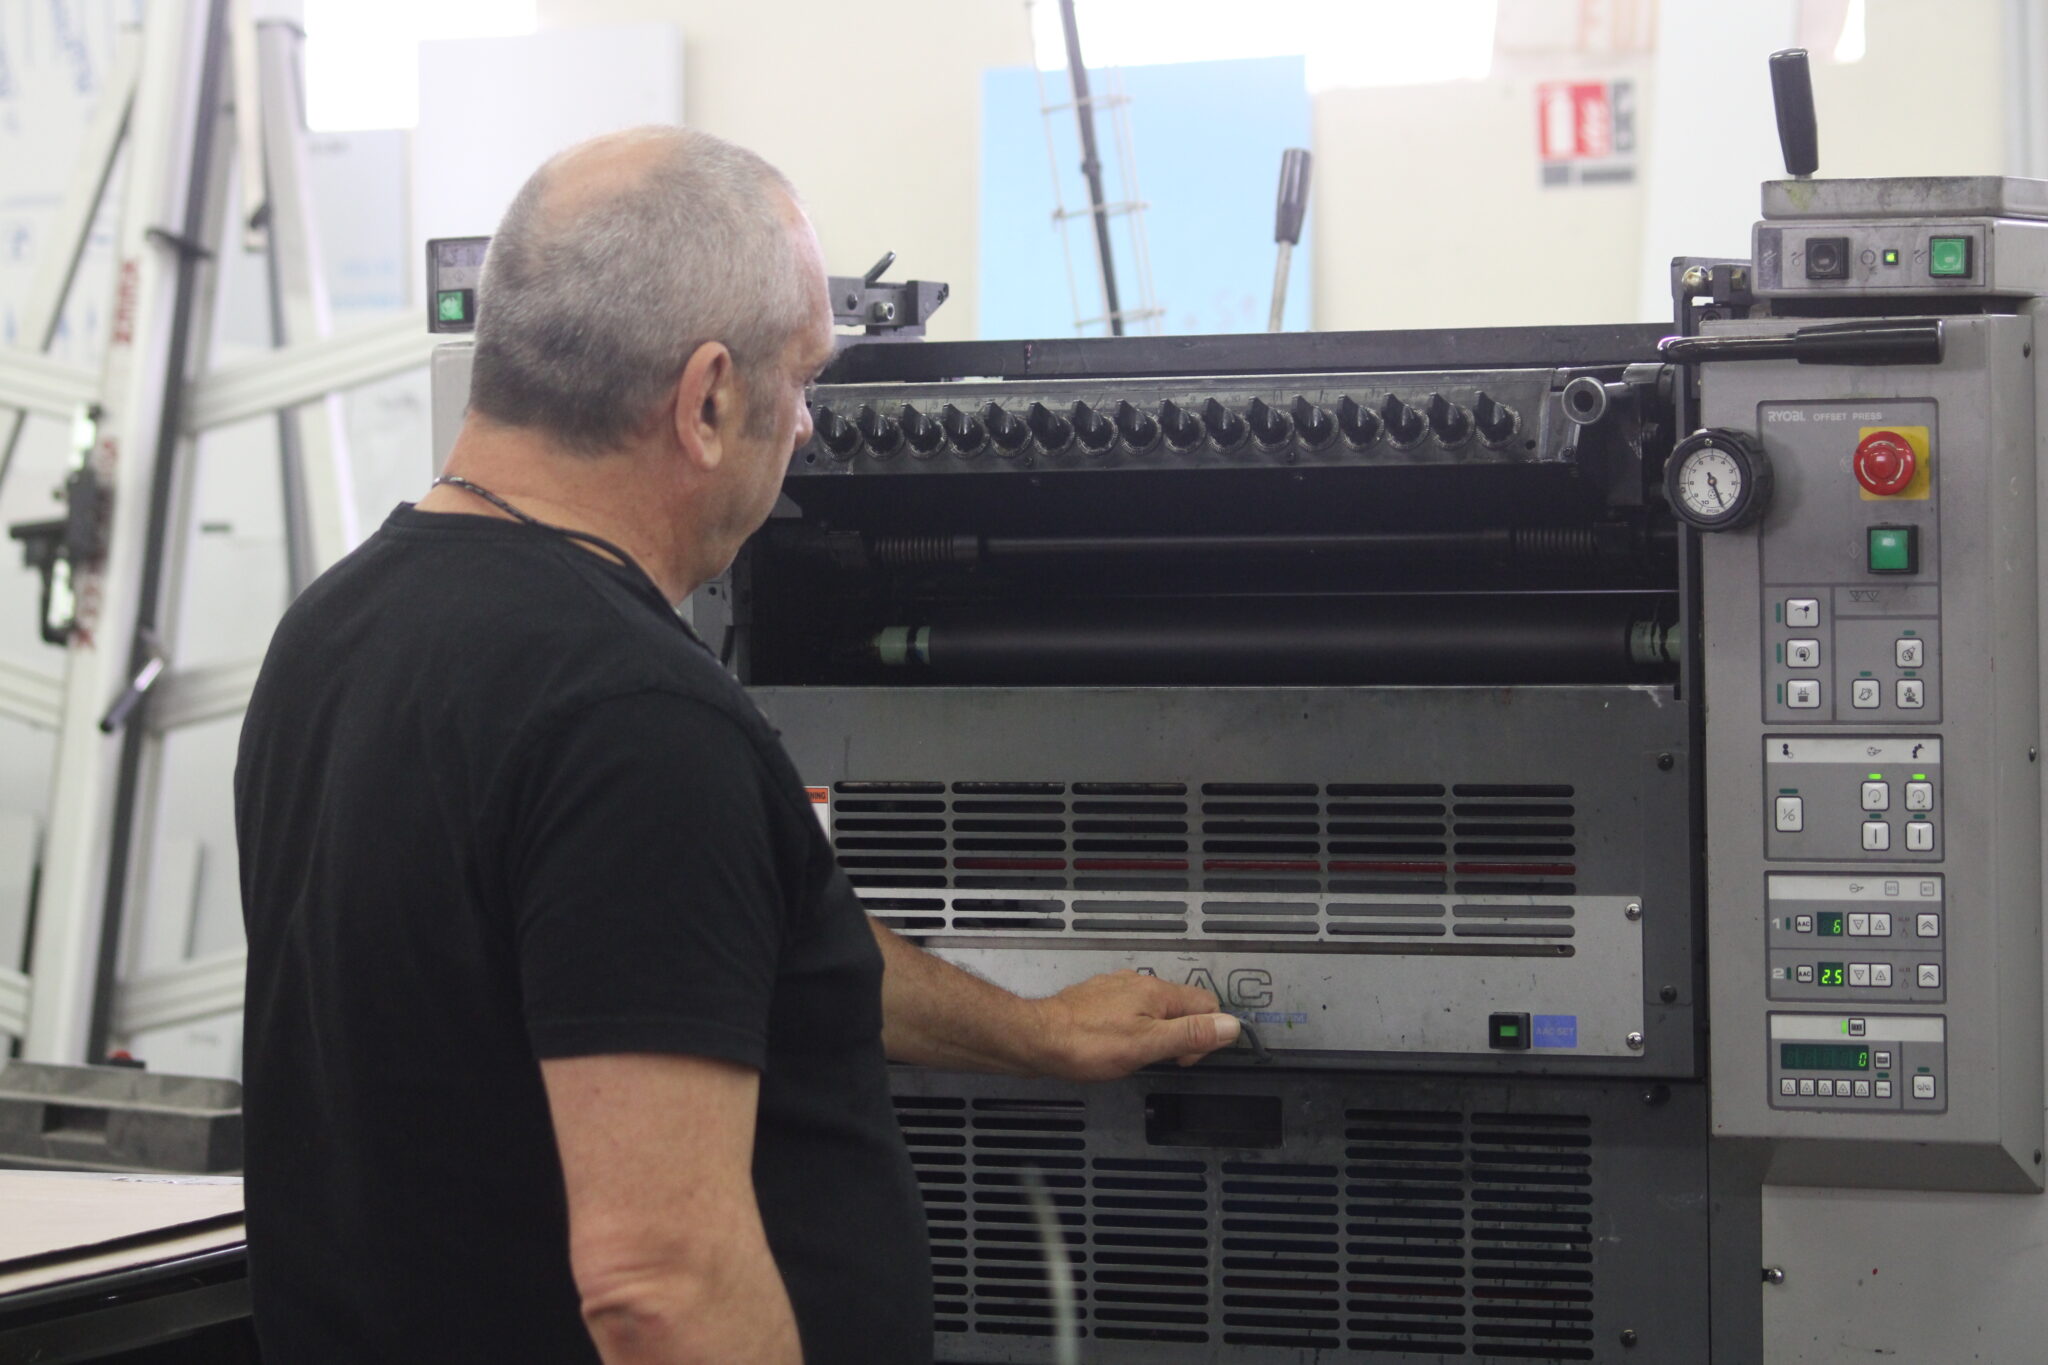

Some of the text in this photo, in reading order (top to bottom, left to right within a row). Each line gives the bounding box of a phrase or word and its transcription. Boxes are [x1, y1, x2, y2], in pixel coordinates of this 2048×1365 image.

[1813, 412, 1847, 422] OFFSET
[1852, 411, 1882, 421] PRESS
[1772, 917, 1781, 929] 1
[1833, 919, 1841, 934] 6
[1772, 967, 1812, 979] 2 AAC
[1137, 967, 1273, 1008] AC
